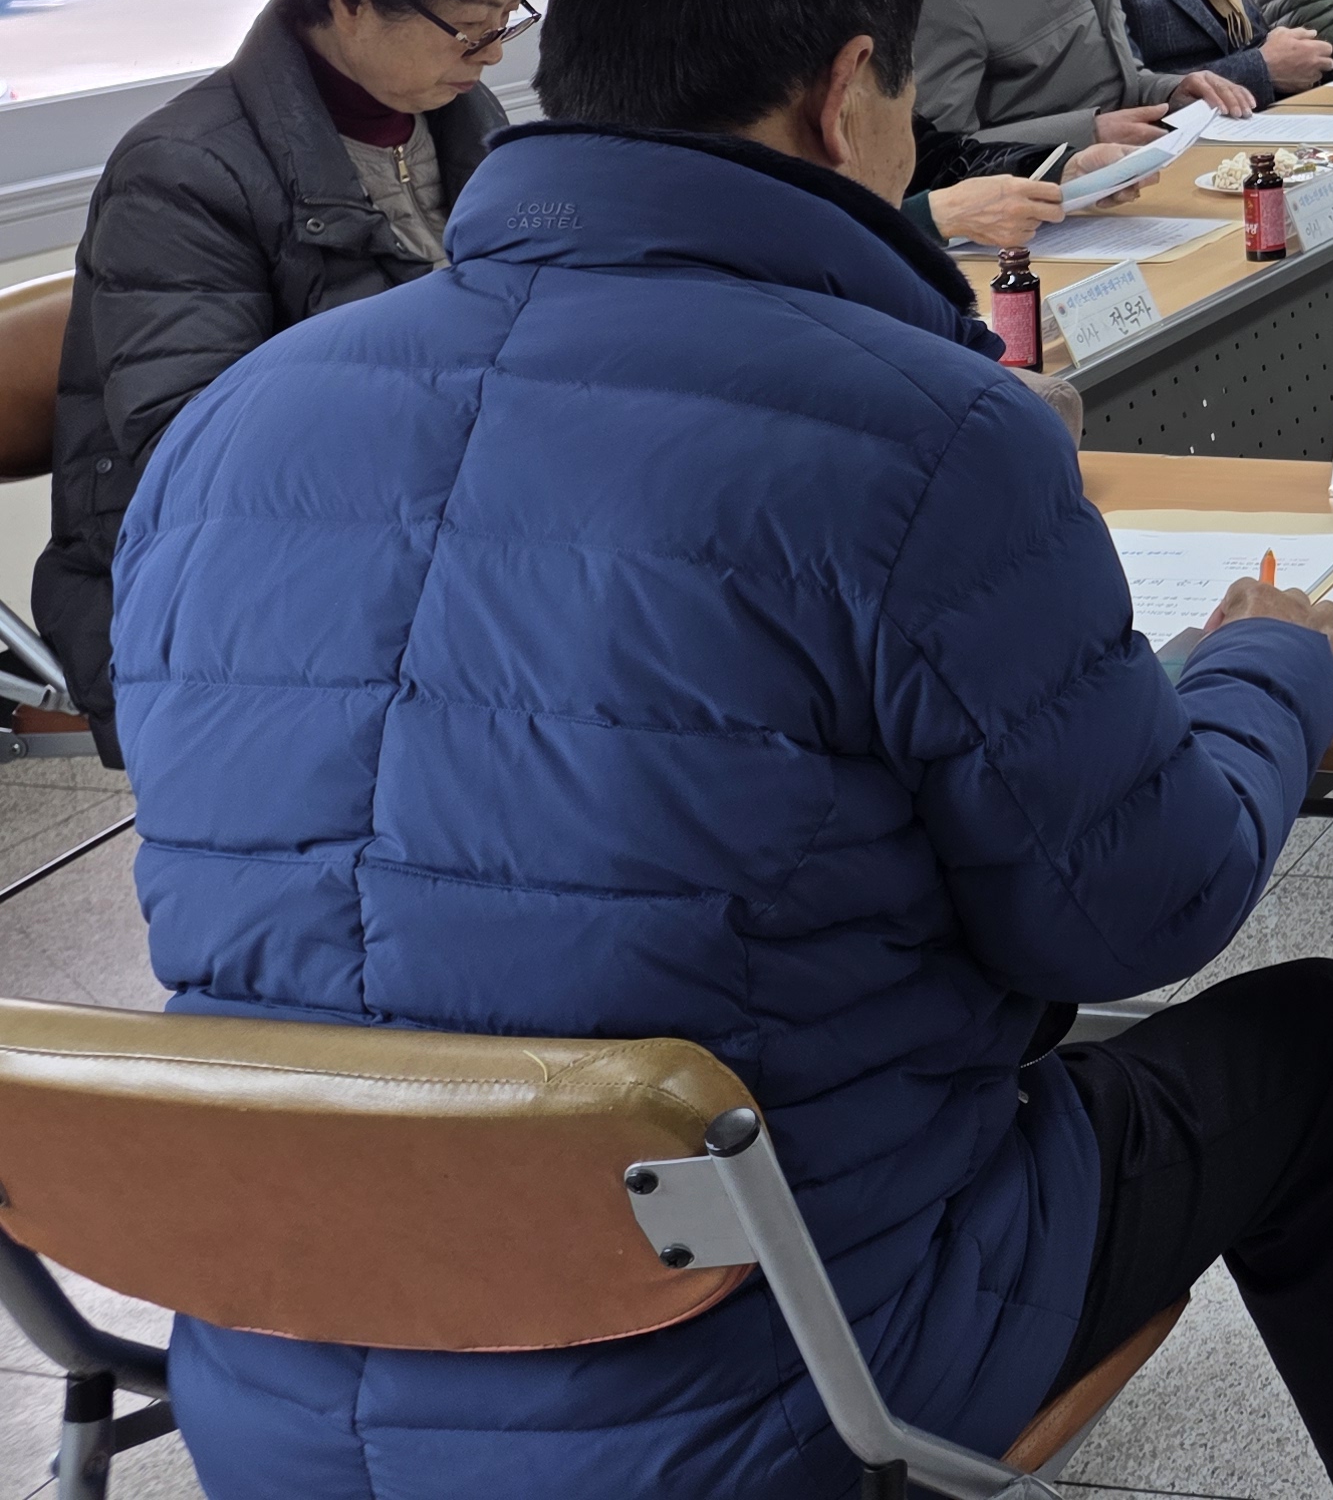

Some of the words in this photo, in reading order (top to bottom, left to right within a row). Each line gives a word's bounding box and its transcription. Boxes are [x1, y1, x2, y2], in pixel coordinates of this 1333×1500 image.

[516, 202, 576, 215] LOUIS
[506, 216, 584, 229] CASTEL
[1076, 322, 1102, 348] 이사
[1108, 295, 1154, 336] 전옥자
